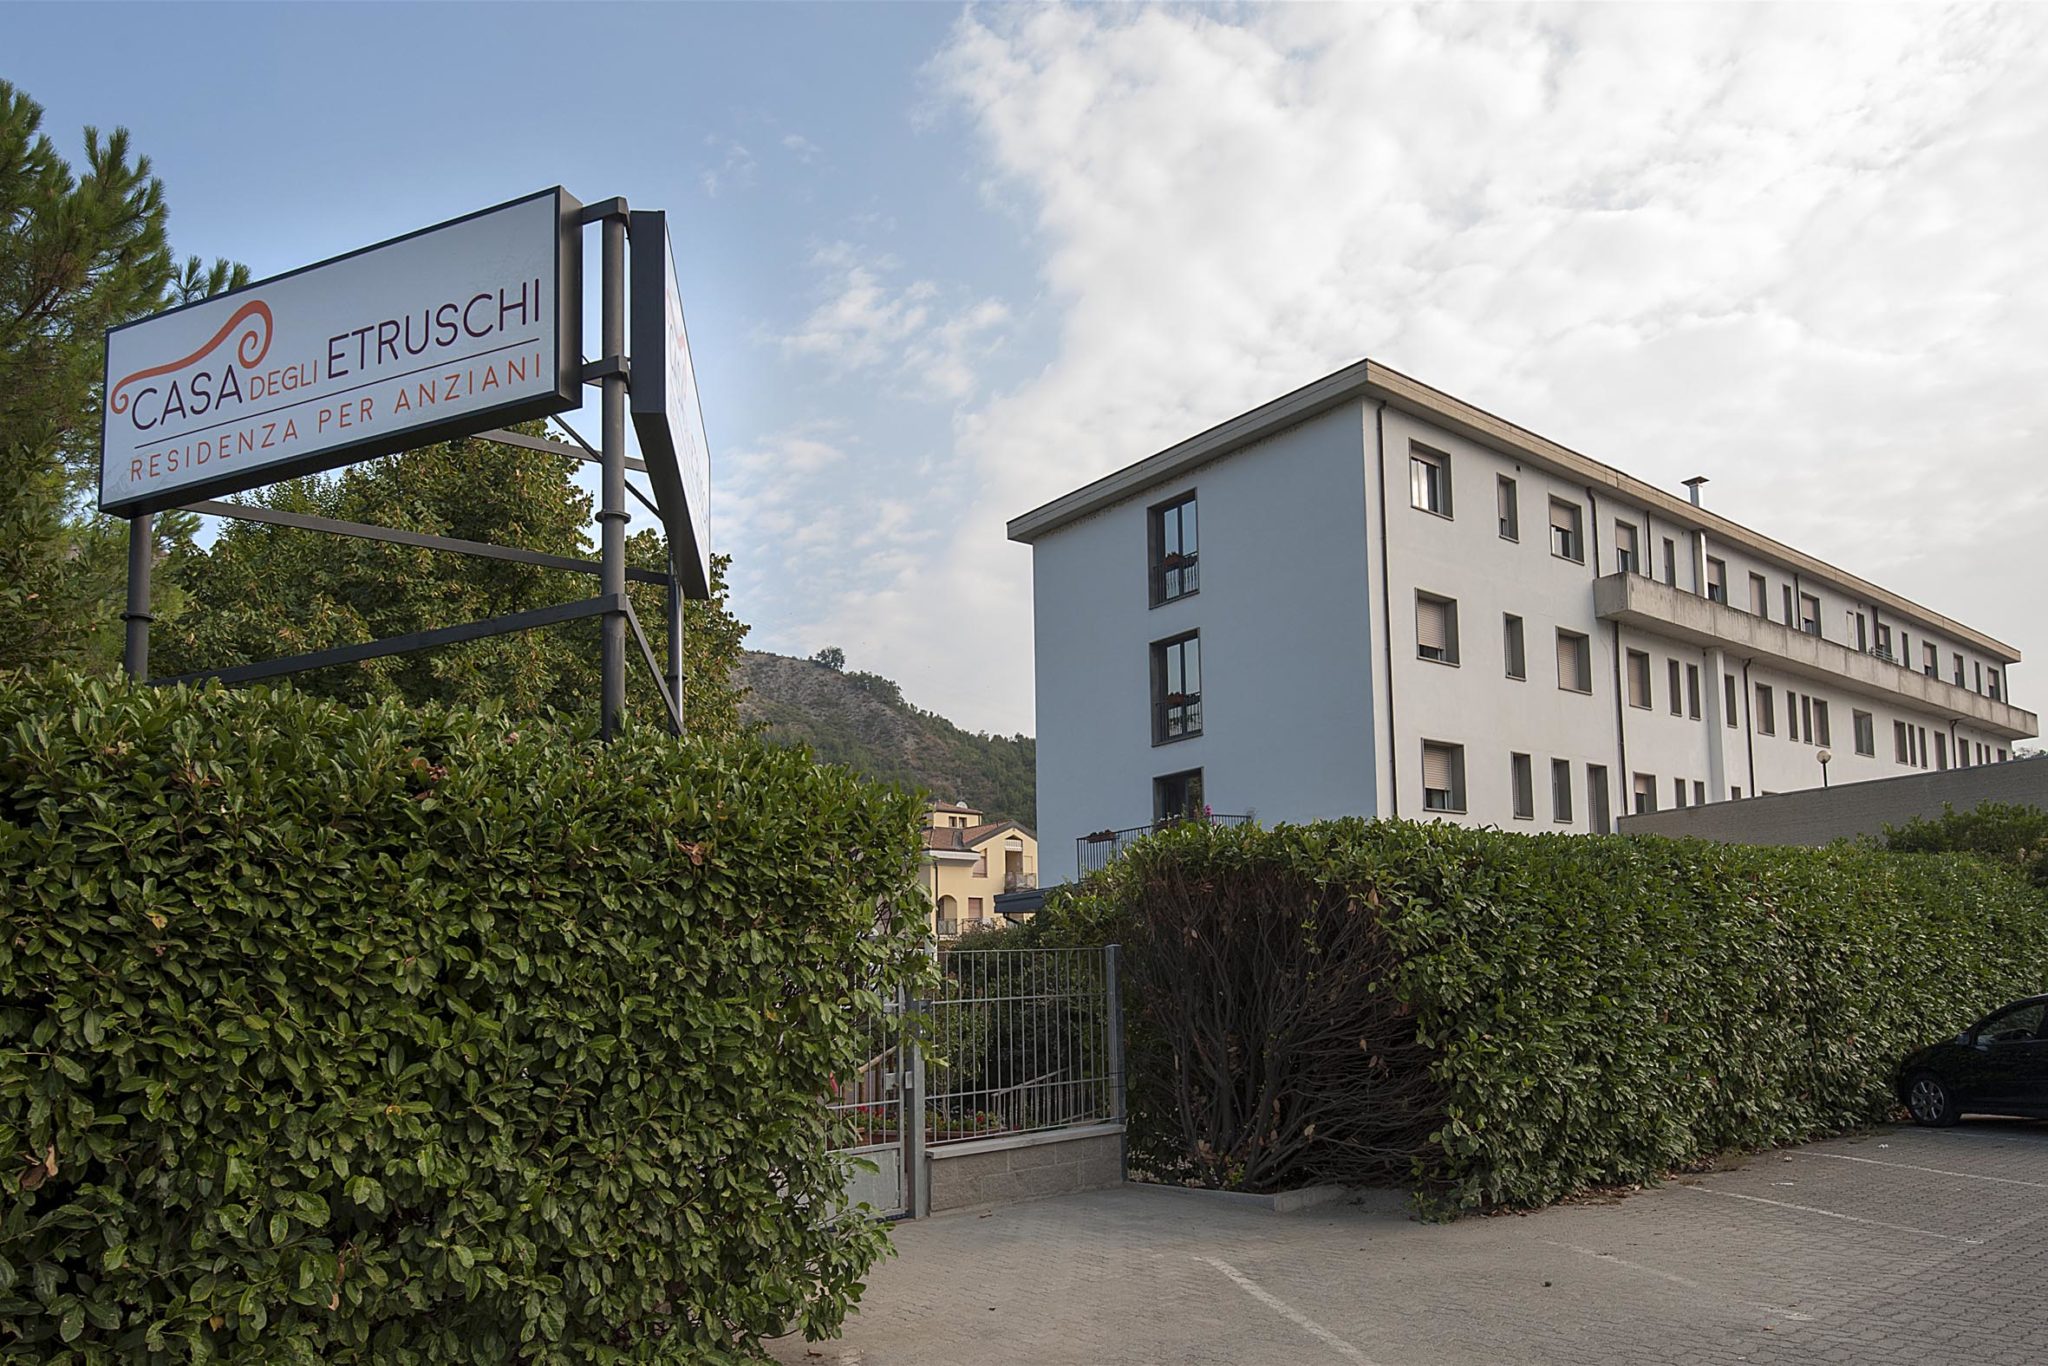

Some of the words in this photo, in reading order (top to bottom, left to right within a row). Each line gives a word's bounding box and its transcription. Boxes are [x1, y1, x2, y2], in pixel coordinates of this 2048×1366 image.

[130, 421, 299, 482] RESIDENZA
[318, 401, 374, 434] PER
[394, 353, 540, 415] ANZIANI
[131, 364, 243, 430] CASA
[249, 359, 318, 401] DEGLI
[328, 278, 540, 380] ETRUSCHI
